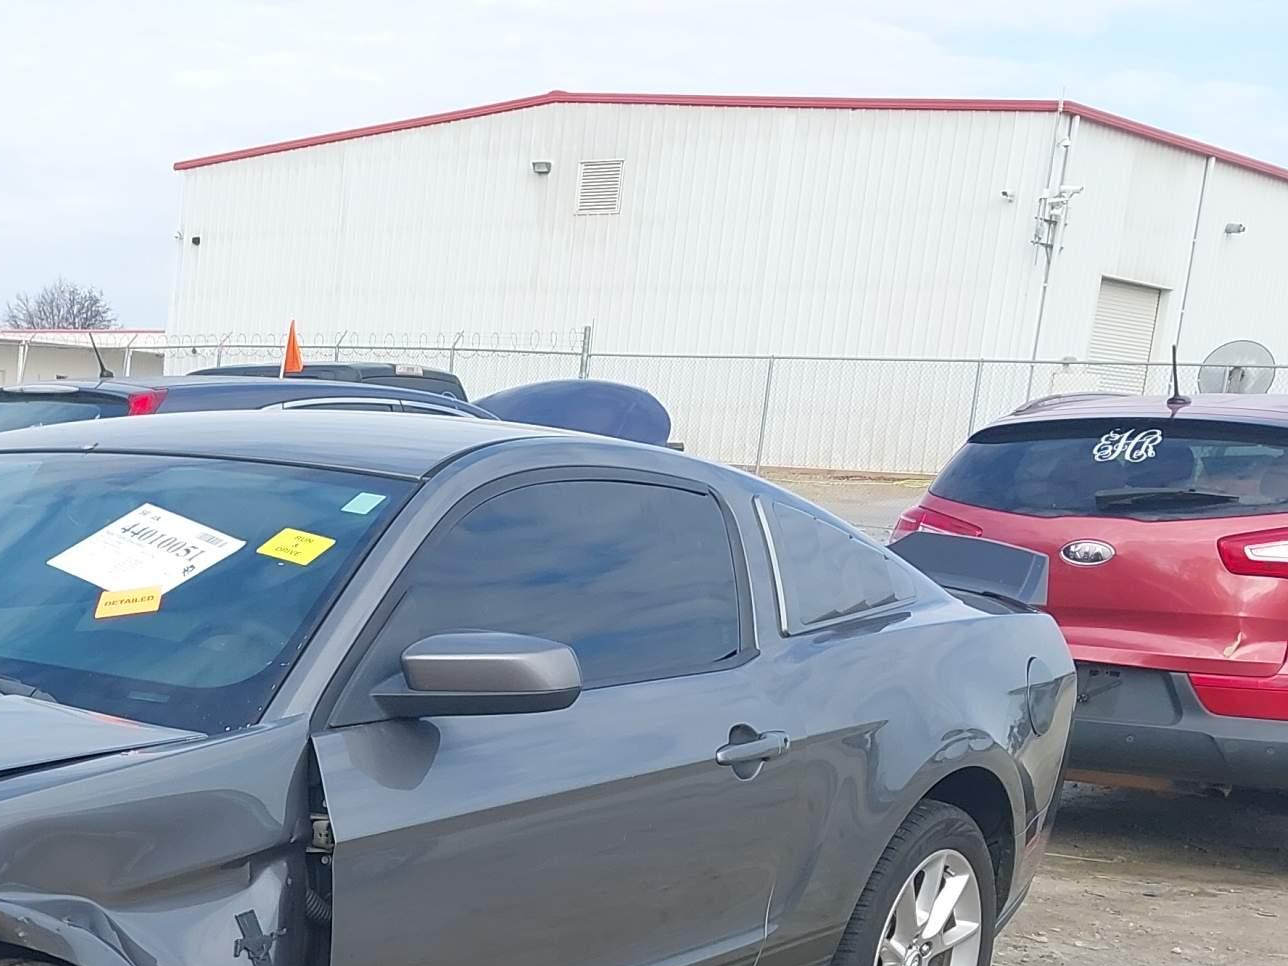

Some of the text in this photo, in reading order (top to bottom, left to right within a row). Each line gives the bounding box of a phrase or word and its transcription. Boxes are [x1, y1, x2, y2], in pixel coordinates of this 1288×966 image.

[121, 522, 206, 563] 44010051
[294, 535, 314, 544] RUN
[274, 546, 302, 556] DRIVE
[104, 595, 155, 607] DETAILED
